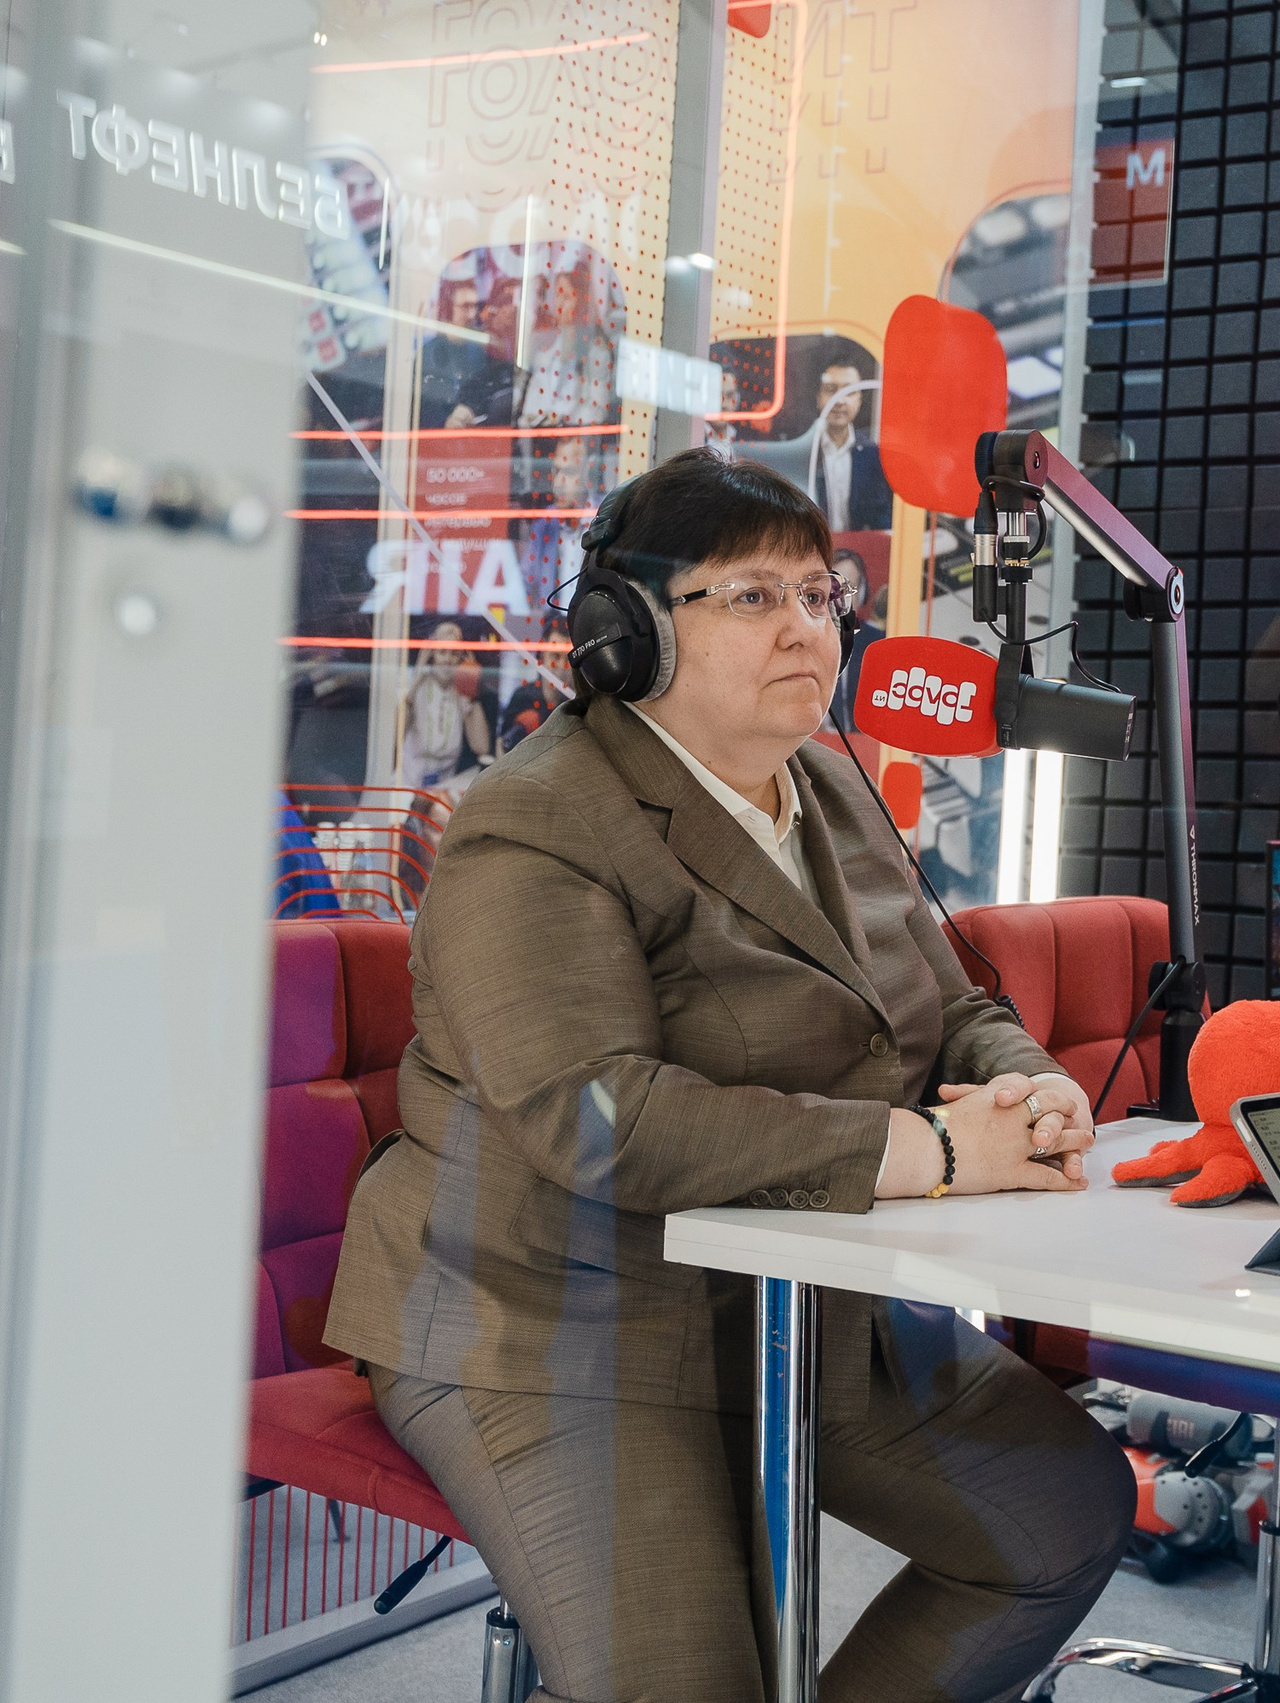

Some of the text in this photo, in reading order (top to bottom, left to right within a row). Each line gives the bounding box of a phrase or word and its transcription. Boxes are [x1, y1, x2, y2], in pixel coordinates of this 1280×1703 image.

[585, 639, 596, 649] PRO
[890, 677, 975, 714] ГОЛОС
[1190, 842, 1200, 926] THRONMAX
